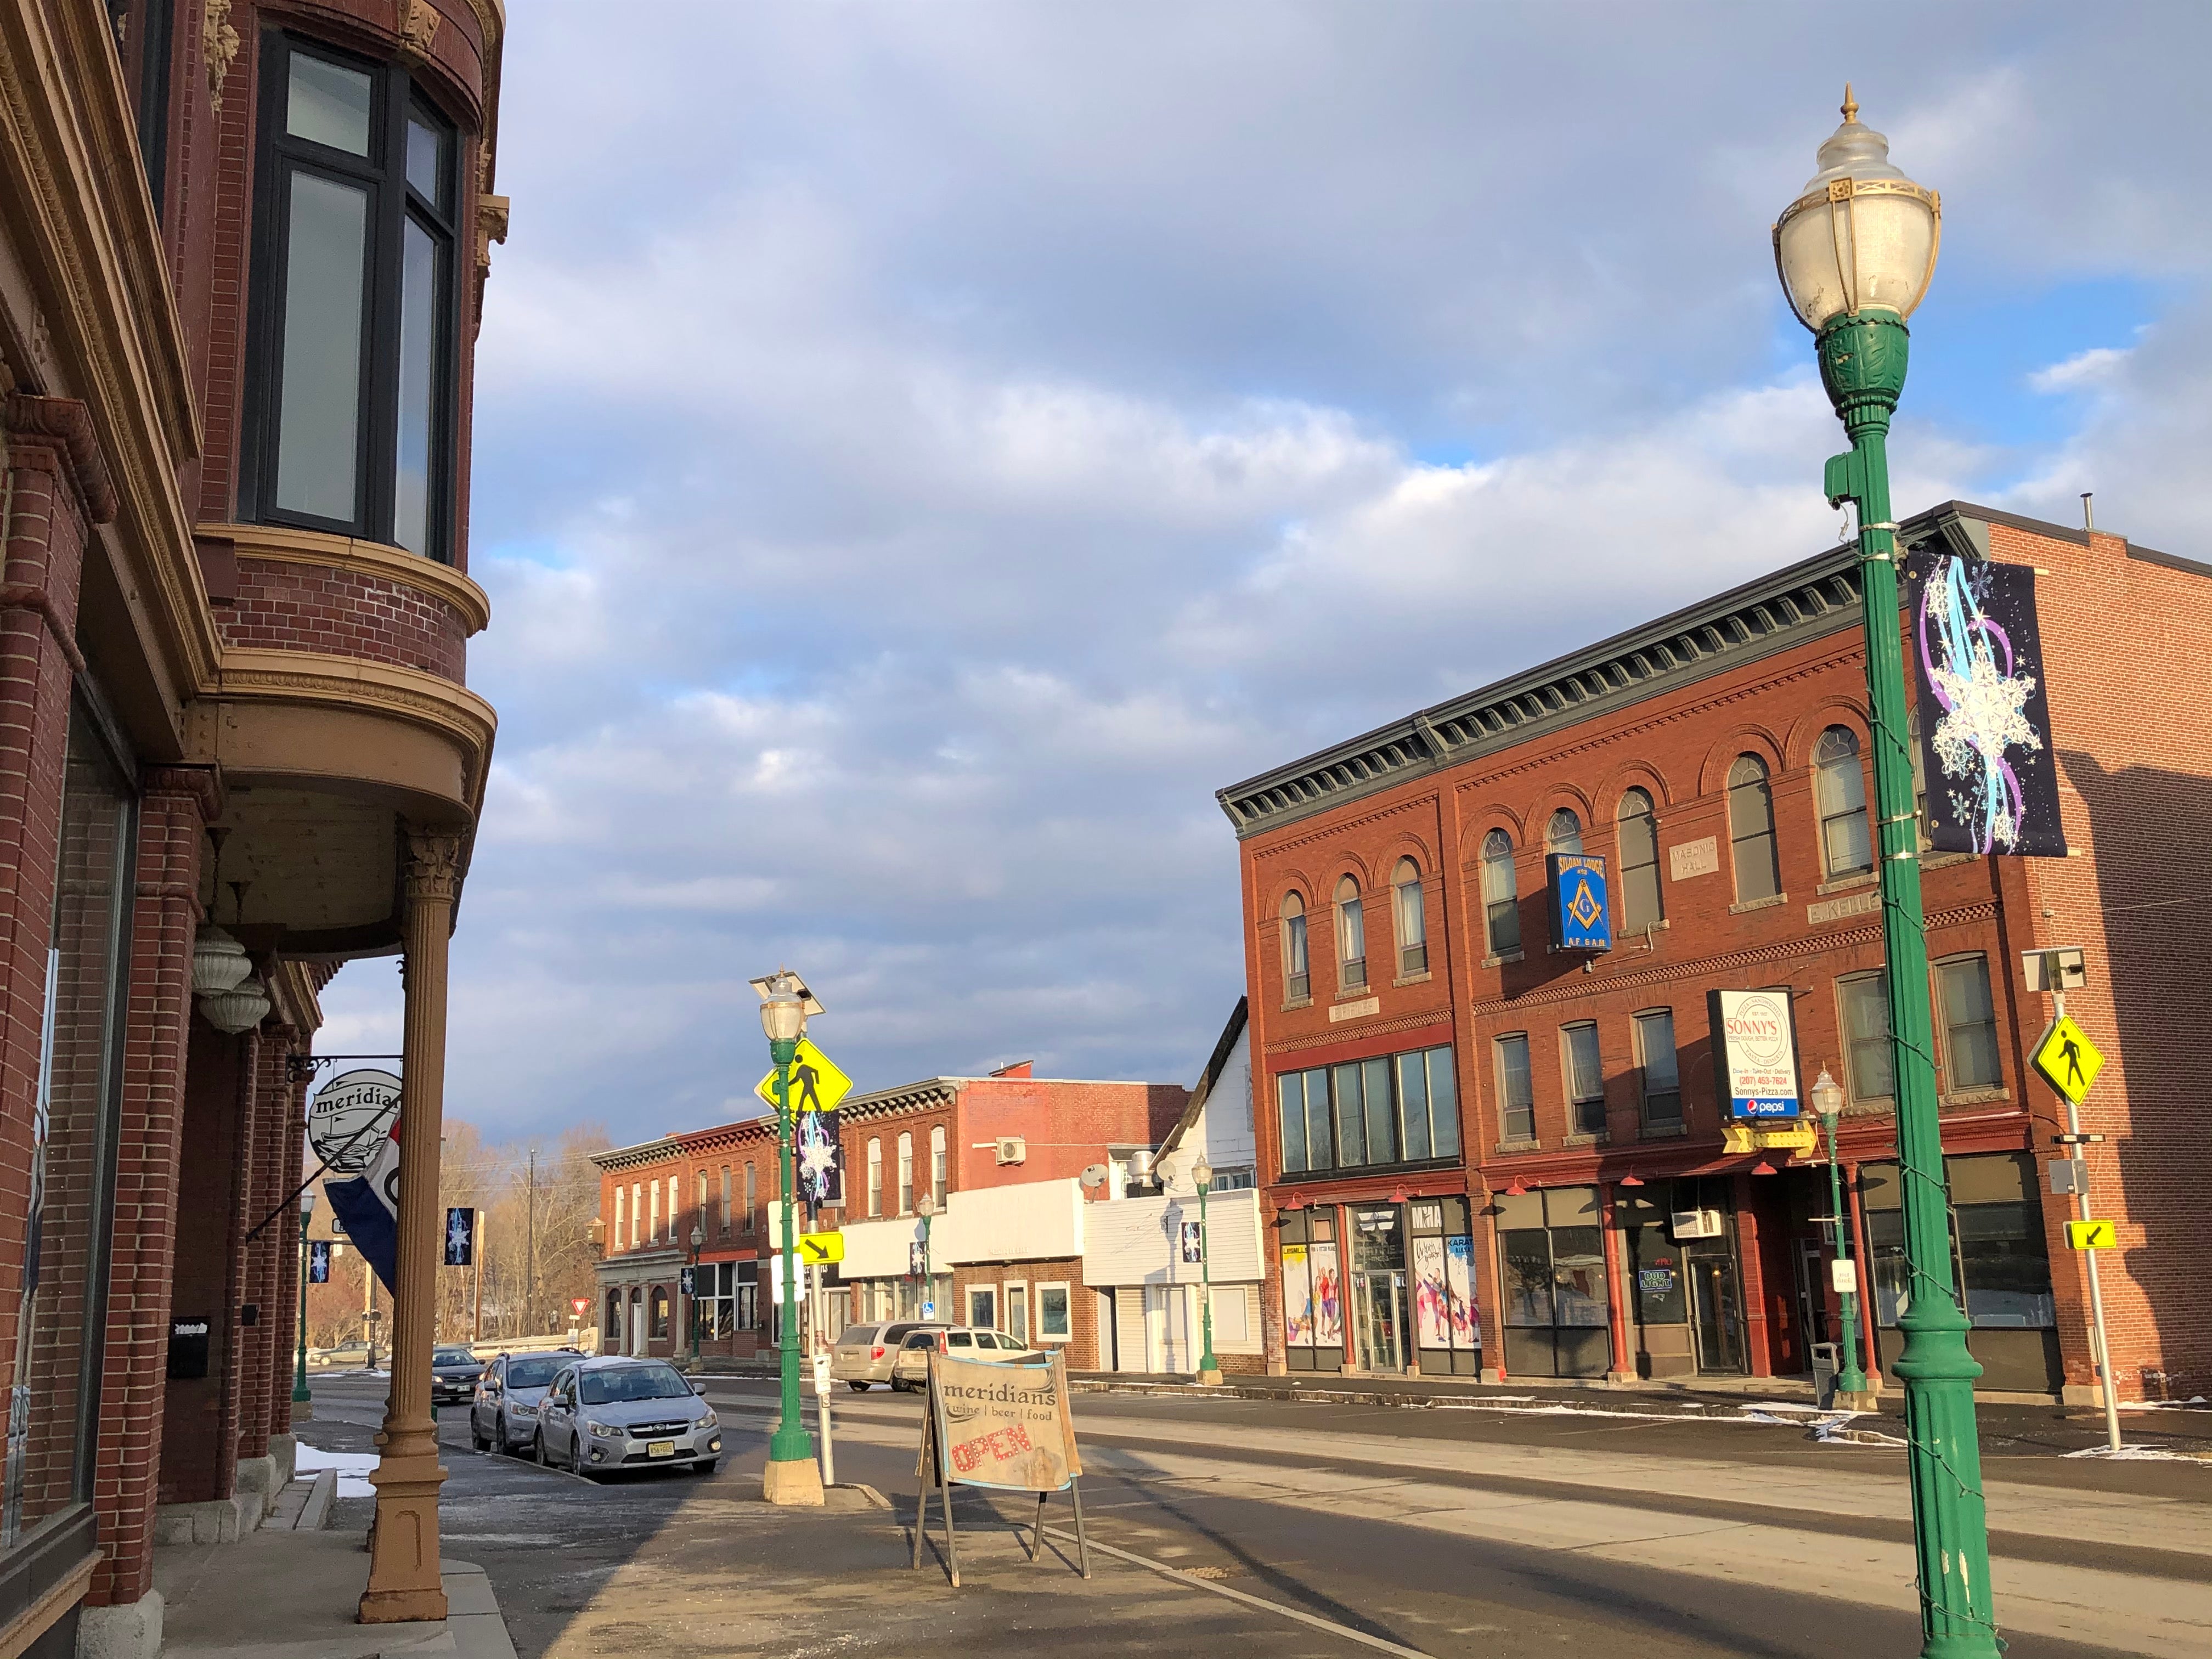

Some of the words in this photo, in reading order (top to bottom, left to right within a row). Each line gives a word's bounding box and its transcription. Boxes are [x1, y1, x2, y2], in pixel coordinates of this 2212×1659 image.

[1671, 842, 1715, 861] MASONIC
[1559, 856, 1582, 875] SILOAM
[1584, 858, 1605, 879] LODGE
[1681, 860, 1706, 874] HALL
[1579, 899, 1590, 912] G
[1752, 998, 1781, 1017] SANDWICHES
[1727, 1019, 1777, 1035] SONNY'S
[1746, 1049, 1760, 1063] PASTA
[1764, 1051, 1784, 1064] DESSERTS
[1740, 1076, 1756, 1086] (207)
[1758, 1076, 1787, 1085] 453-7624
[1735, 1087, 1793, 1097] Sonnys-Pizza.com
[1759, 1101, 1785, 1114] pepsi
[1644, 1271, 1665, 1280] BUD
[1641, 1279, 1669, 1288] LIGHT
[944, 1383, 1056, 1406] meridians
[952, 1404, 980, 1414] wine
[991, 1406, 1016, 1418] beer
[1026, 1409, 1052, 1421] food
[951, 1423, 1032, 1472] OPEN
